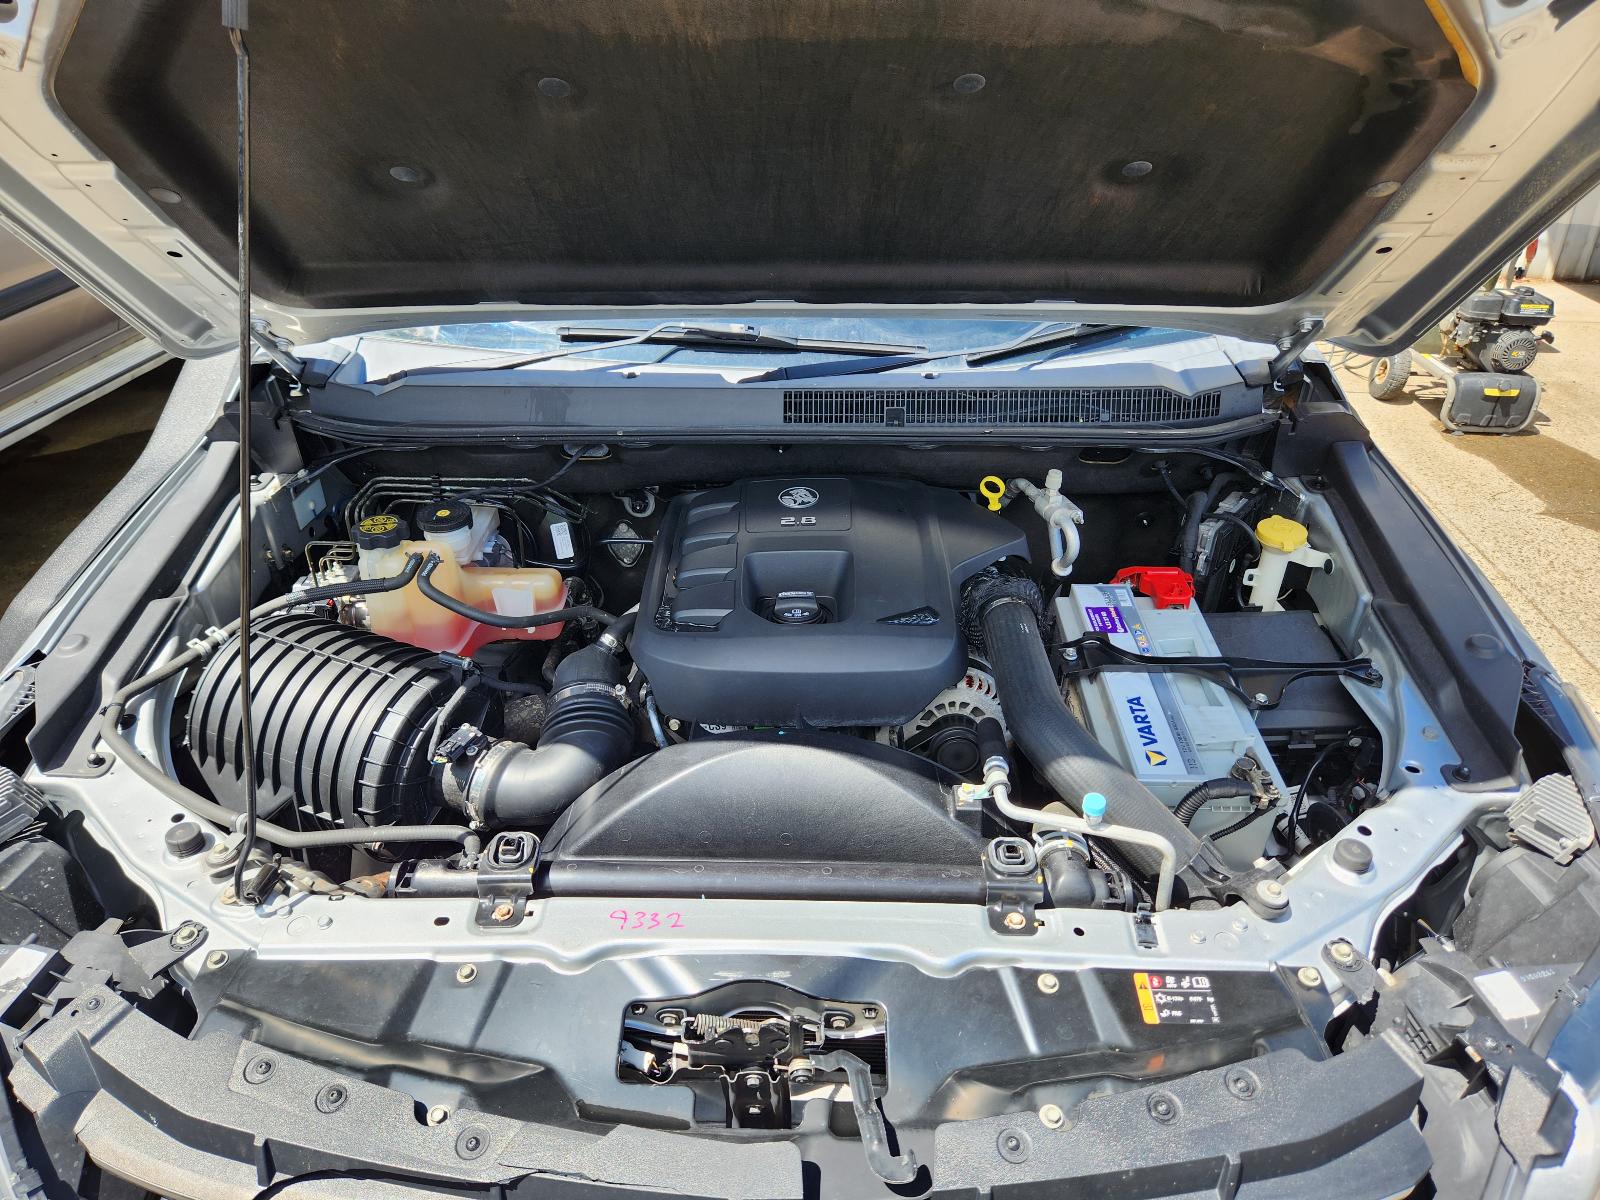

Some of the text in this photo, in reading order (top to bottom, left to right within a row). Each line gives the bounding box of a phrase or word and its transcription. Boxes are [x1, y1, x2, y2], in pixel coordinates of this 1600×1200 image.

[780, 516, 817, 525] 2.8
[1126, 696, 1159, 747] VARTA
[609, 909, 685, 930] 9332
